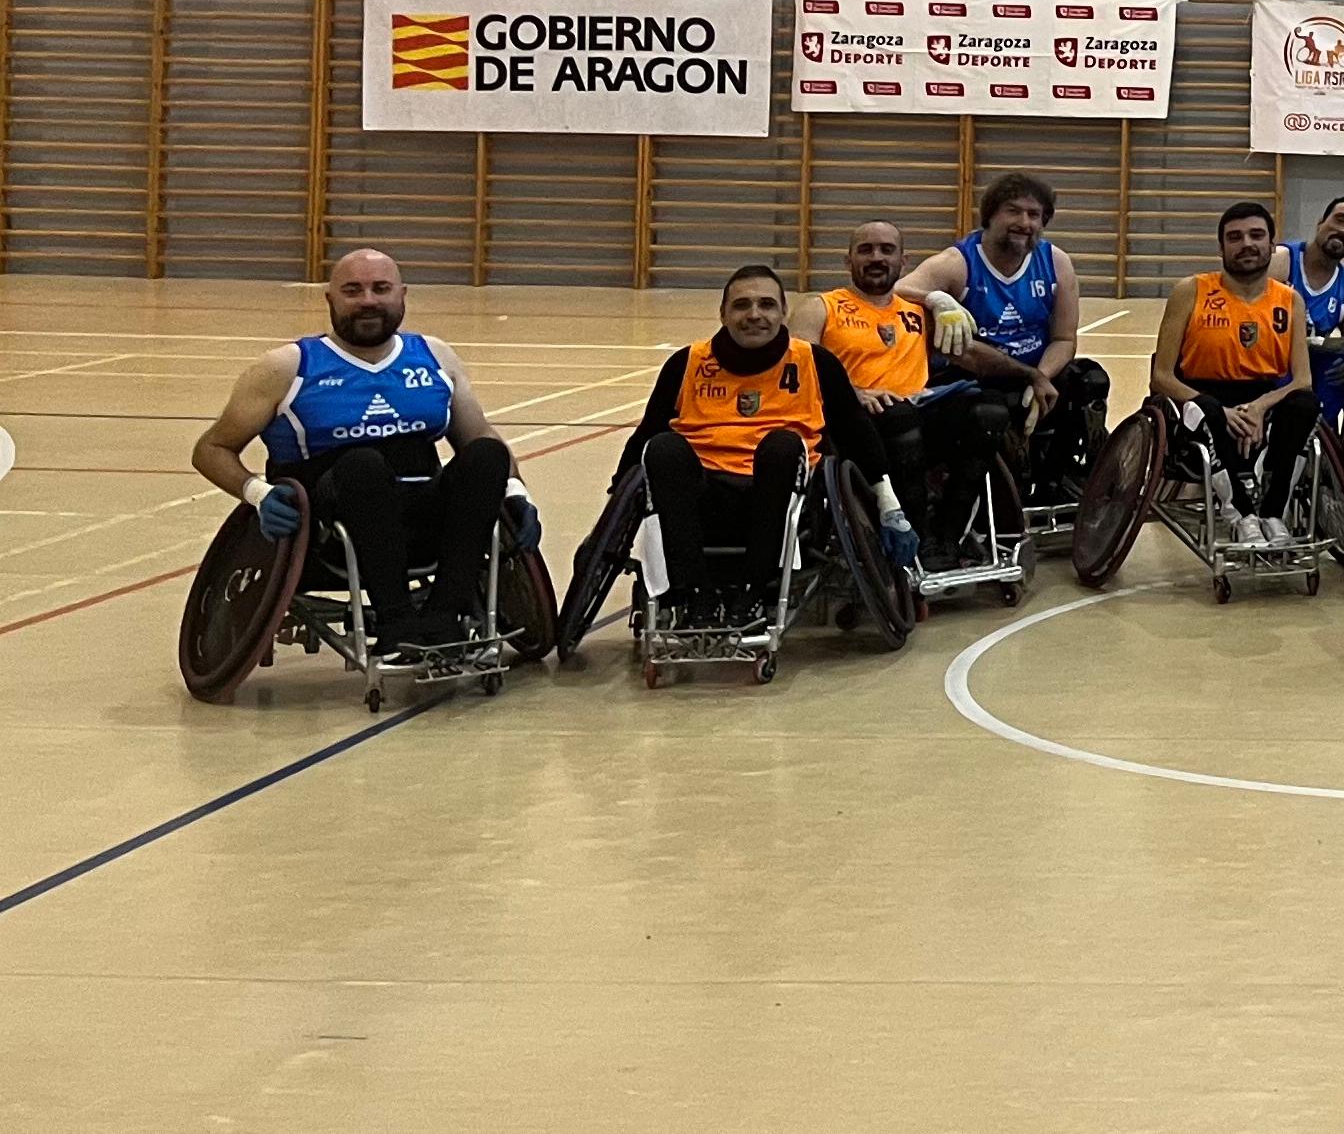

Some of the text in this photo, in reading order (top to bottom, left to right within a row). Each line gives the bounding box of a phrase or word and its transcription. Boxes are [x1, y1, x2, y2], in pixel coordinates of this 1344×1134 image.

[475, 13, 716, 54] GOBIERNO
[830, 31, 903, 49] Zaragoza
[958, 33, 1031, 51] Zaragoza
[1085, 36, 1158, 54] Zaragoza
[475, 56, 749, 95] DE ARAGON
[1295, 70, 1320, 85] LIGA
[1029, 279, 1046, 298] 16
[896, 310, 923, 336] 13
[1272, 306, 1289, 334] 9
[402, 366, 434, 389] 22
[778, 362, 801, 394] 4
[332, 418, 427, 439] adapta
